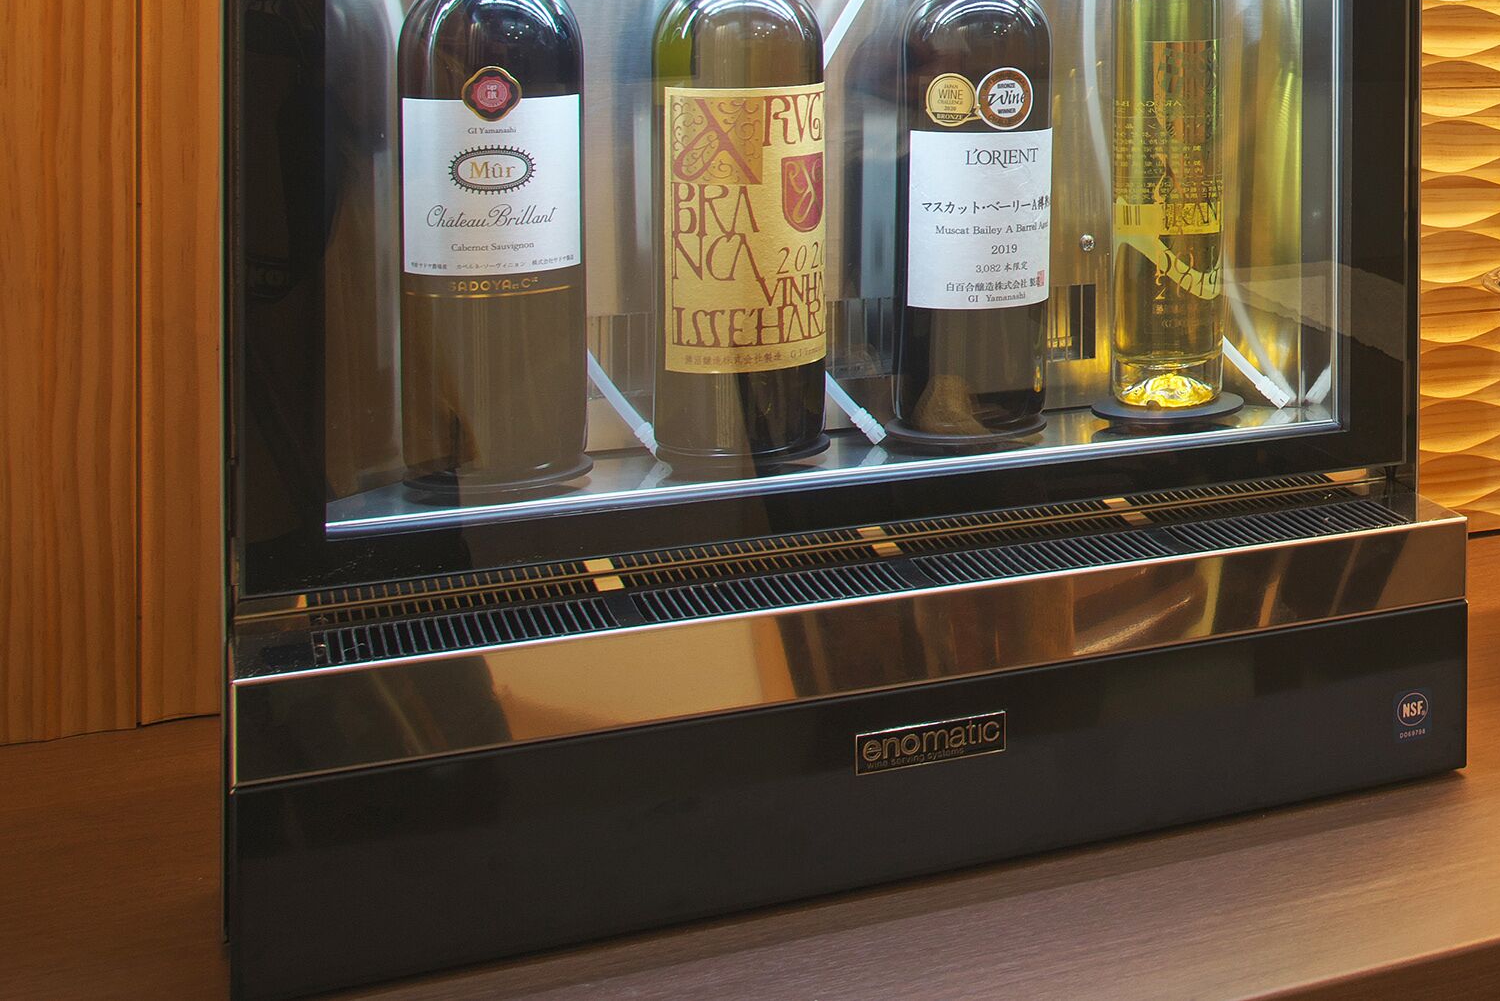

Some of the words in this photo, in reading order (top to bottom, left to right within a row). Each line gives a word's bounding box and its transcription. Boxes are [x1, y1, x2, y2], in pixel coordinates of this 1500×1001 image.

[938, 89, 964, 99] WINE
[469, 161, 515, 179] Mûr
[486, 203, 557, 228] Brillant
[936, 225, 970, 235] Muscat
[973, 225, 1003, 236] Bailey
[1006, 225, 1014, 234] A
[451, 243, 489, 253] Cabernet
[491, 241, 535, 253] Sauvignon
[991, 244, 1019, 255] 2019
[975, 264, 1001, 274] 3,082
[450, 279, 512, 292] SADOYA
[967, 295, 979, 303] GI
[986, 291, 1026, 303] Yamanashi
[1402, 700, 1424, 718] NSF
[862, 720, 1000, 762] enomatic
